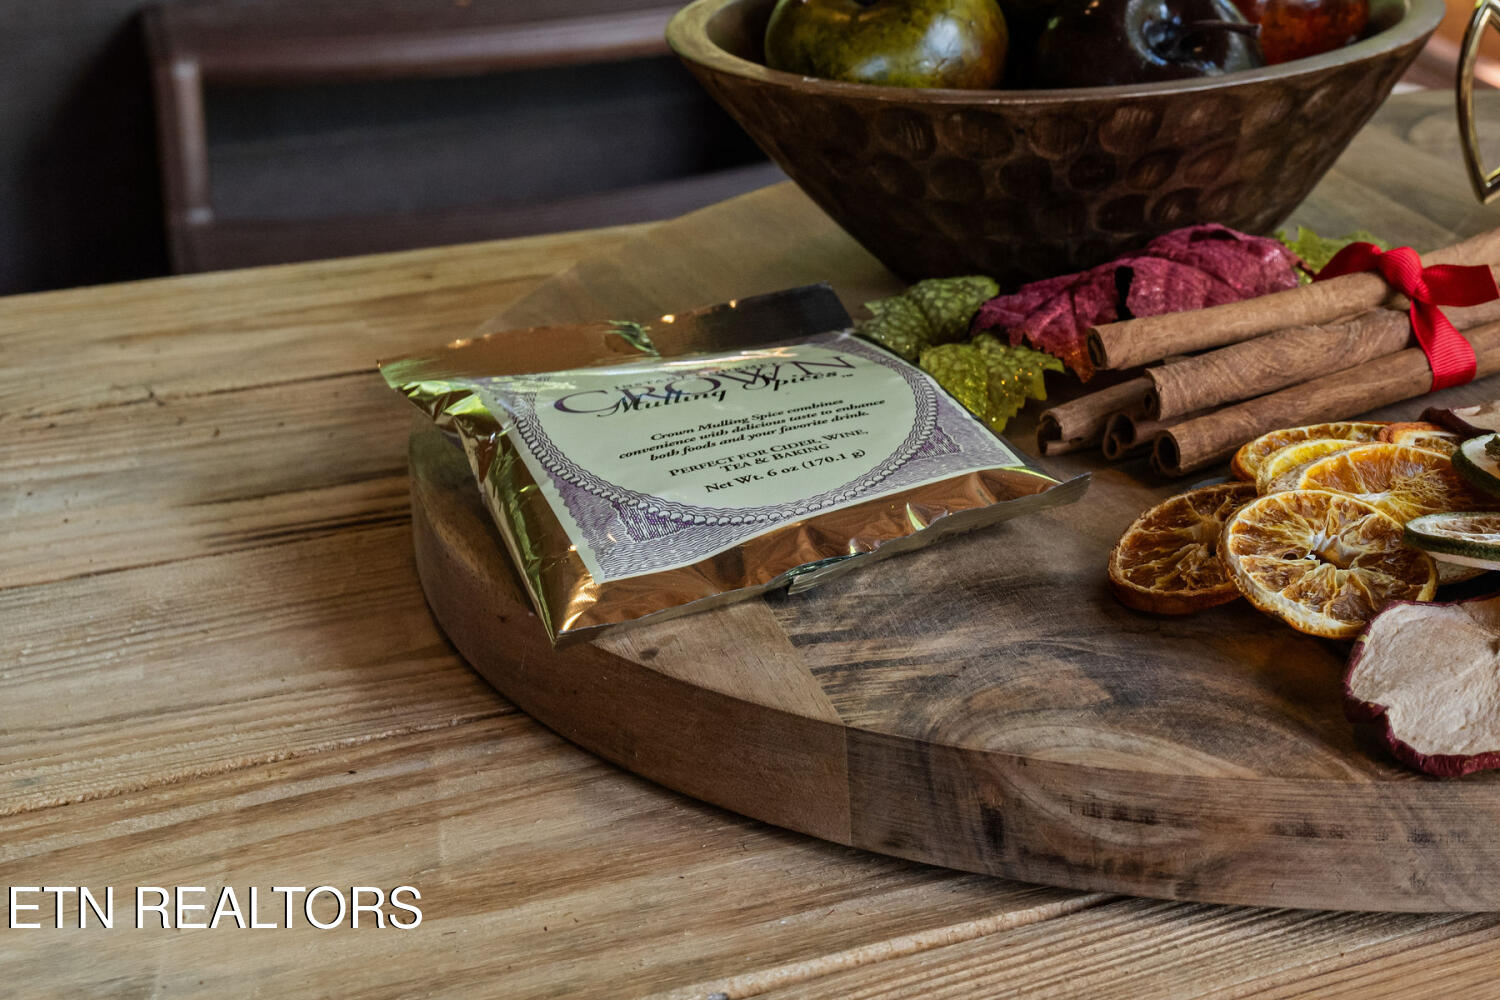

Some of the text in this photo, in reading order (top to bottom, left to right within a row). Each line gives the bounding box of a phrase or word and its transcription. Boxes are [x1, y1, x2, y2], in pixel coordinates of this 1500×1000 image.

[554, 356, 856, 414] CROWN
[597, 389, 727, 418] Mulling
[619, 436, 697, 459] convenience
[700, 429, 728, 441] with
[732, 418, 786, 434] delicious
[789, 411, 817, 422] taste
[836, 399, 886, 413] enhance
[650, 410, 870, 461] both foods and your favorite drink.
[651, 399, 844, 441] Crown Mulling Spice combines
[669, 455, 735, 477] PERFECT
[738, 449, 768, 461] FOR
[704, 448, 867, 493] Net Wt. 6 oz (170.1 g)
[720, 443, 831, 473] TEA & BAKING
